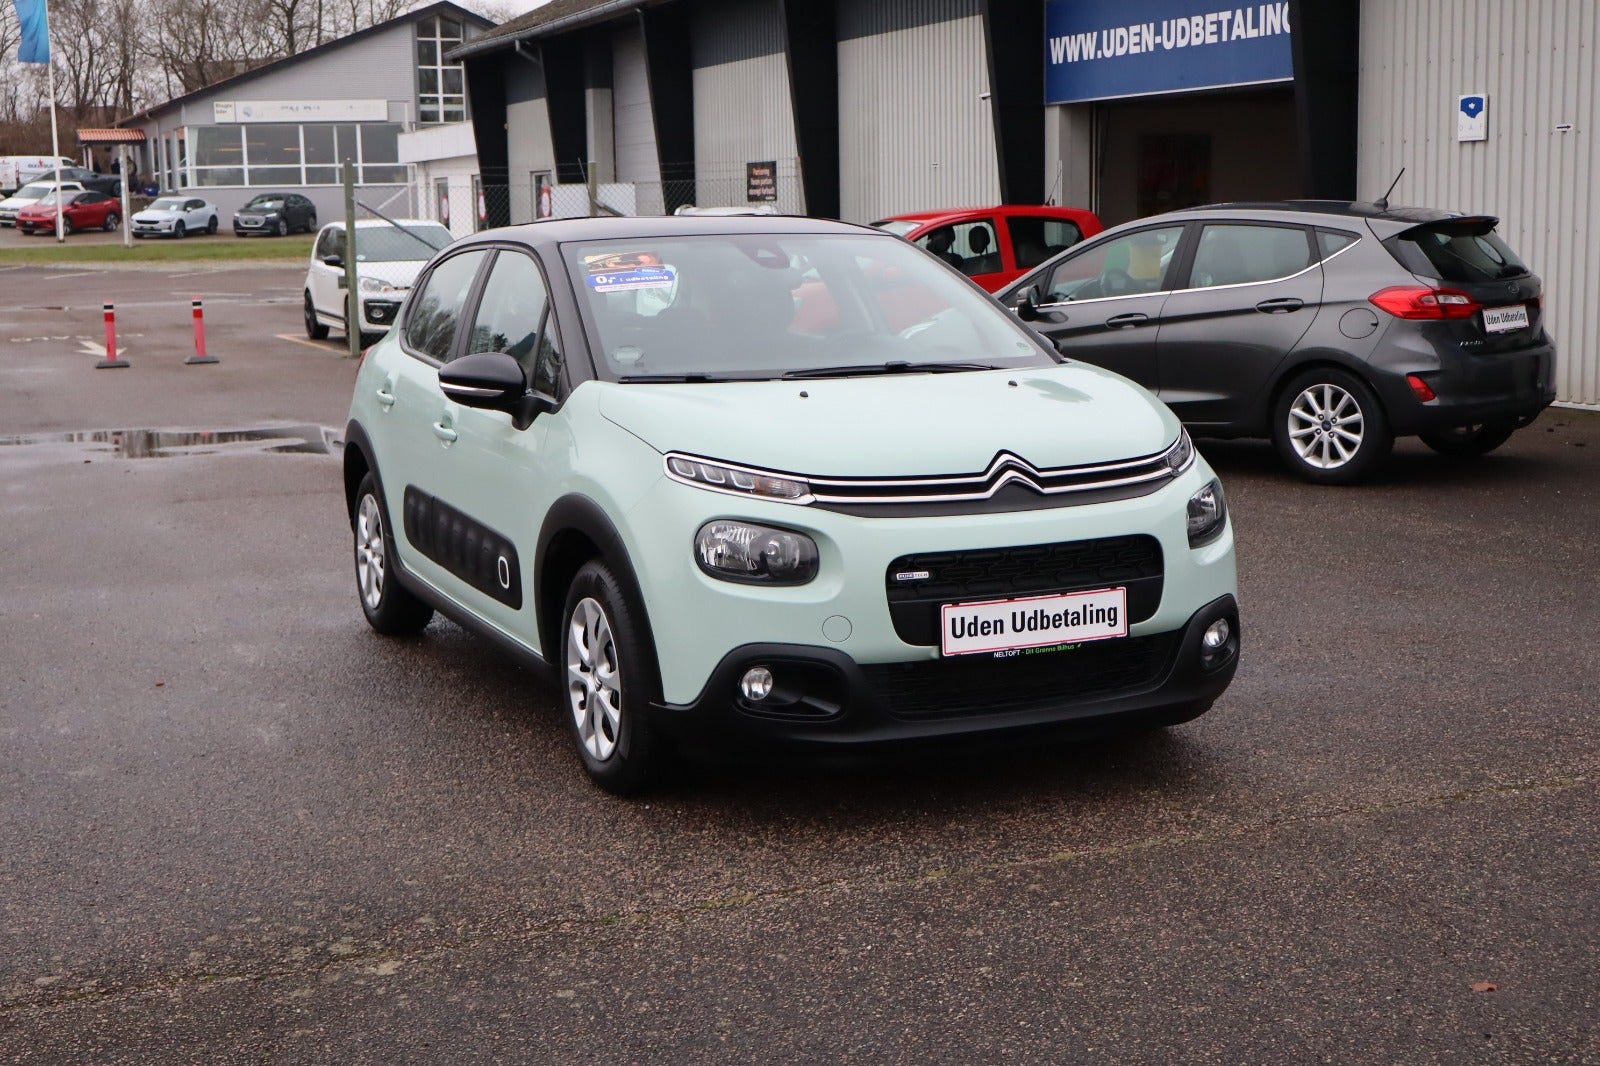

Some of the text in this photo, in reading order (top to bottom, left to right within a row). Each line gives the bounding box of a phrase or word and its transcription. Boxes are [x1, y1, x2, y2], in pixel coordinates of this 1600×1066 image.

[1486, 314, 1500, 325] Uden
[951, 603, 1118, 639] Uden Udbetaling
[993, 649, 1021, 659] NELTOFT
